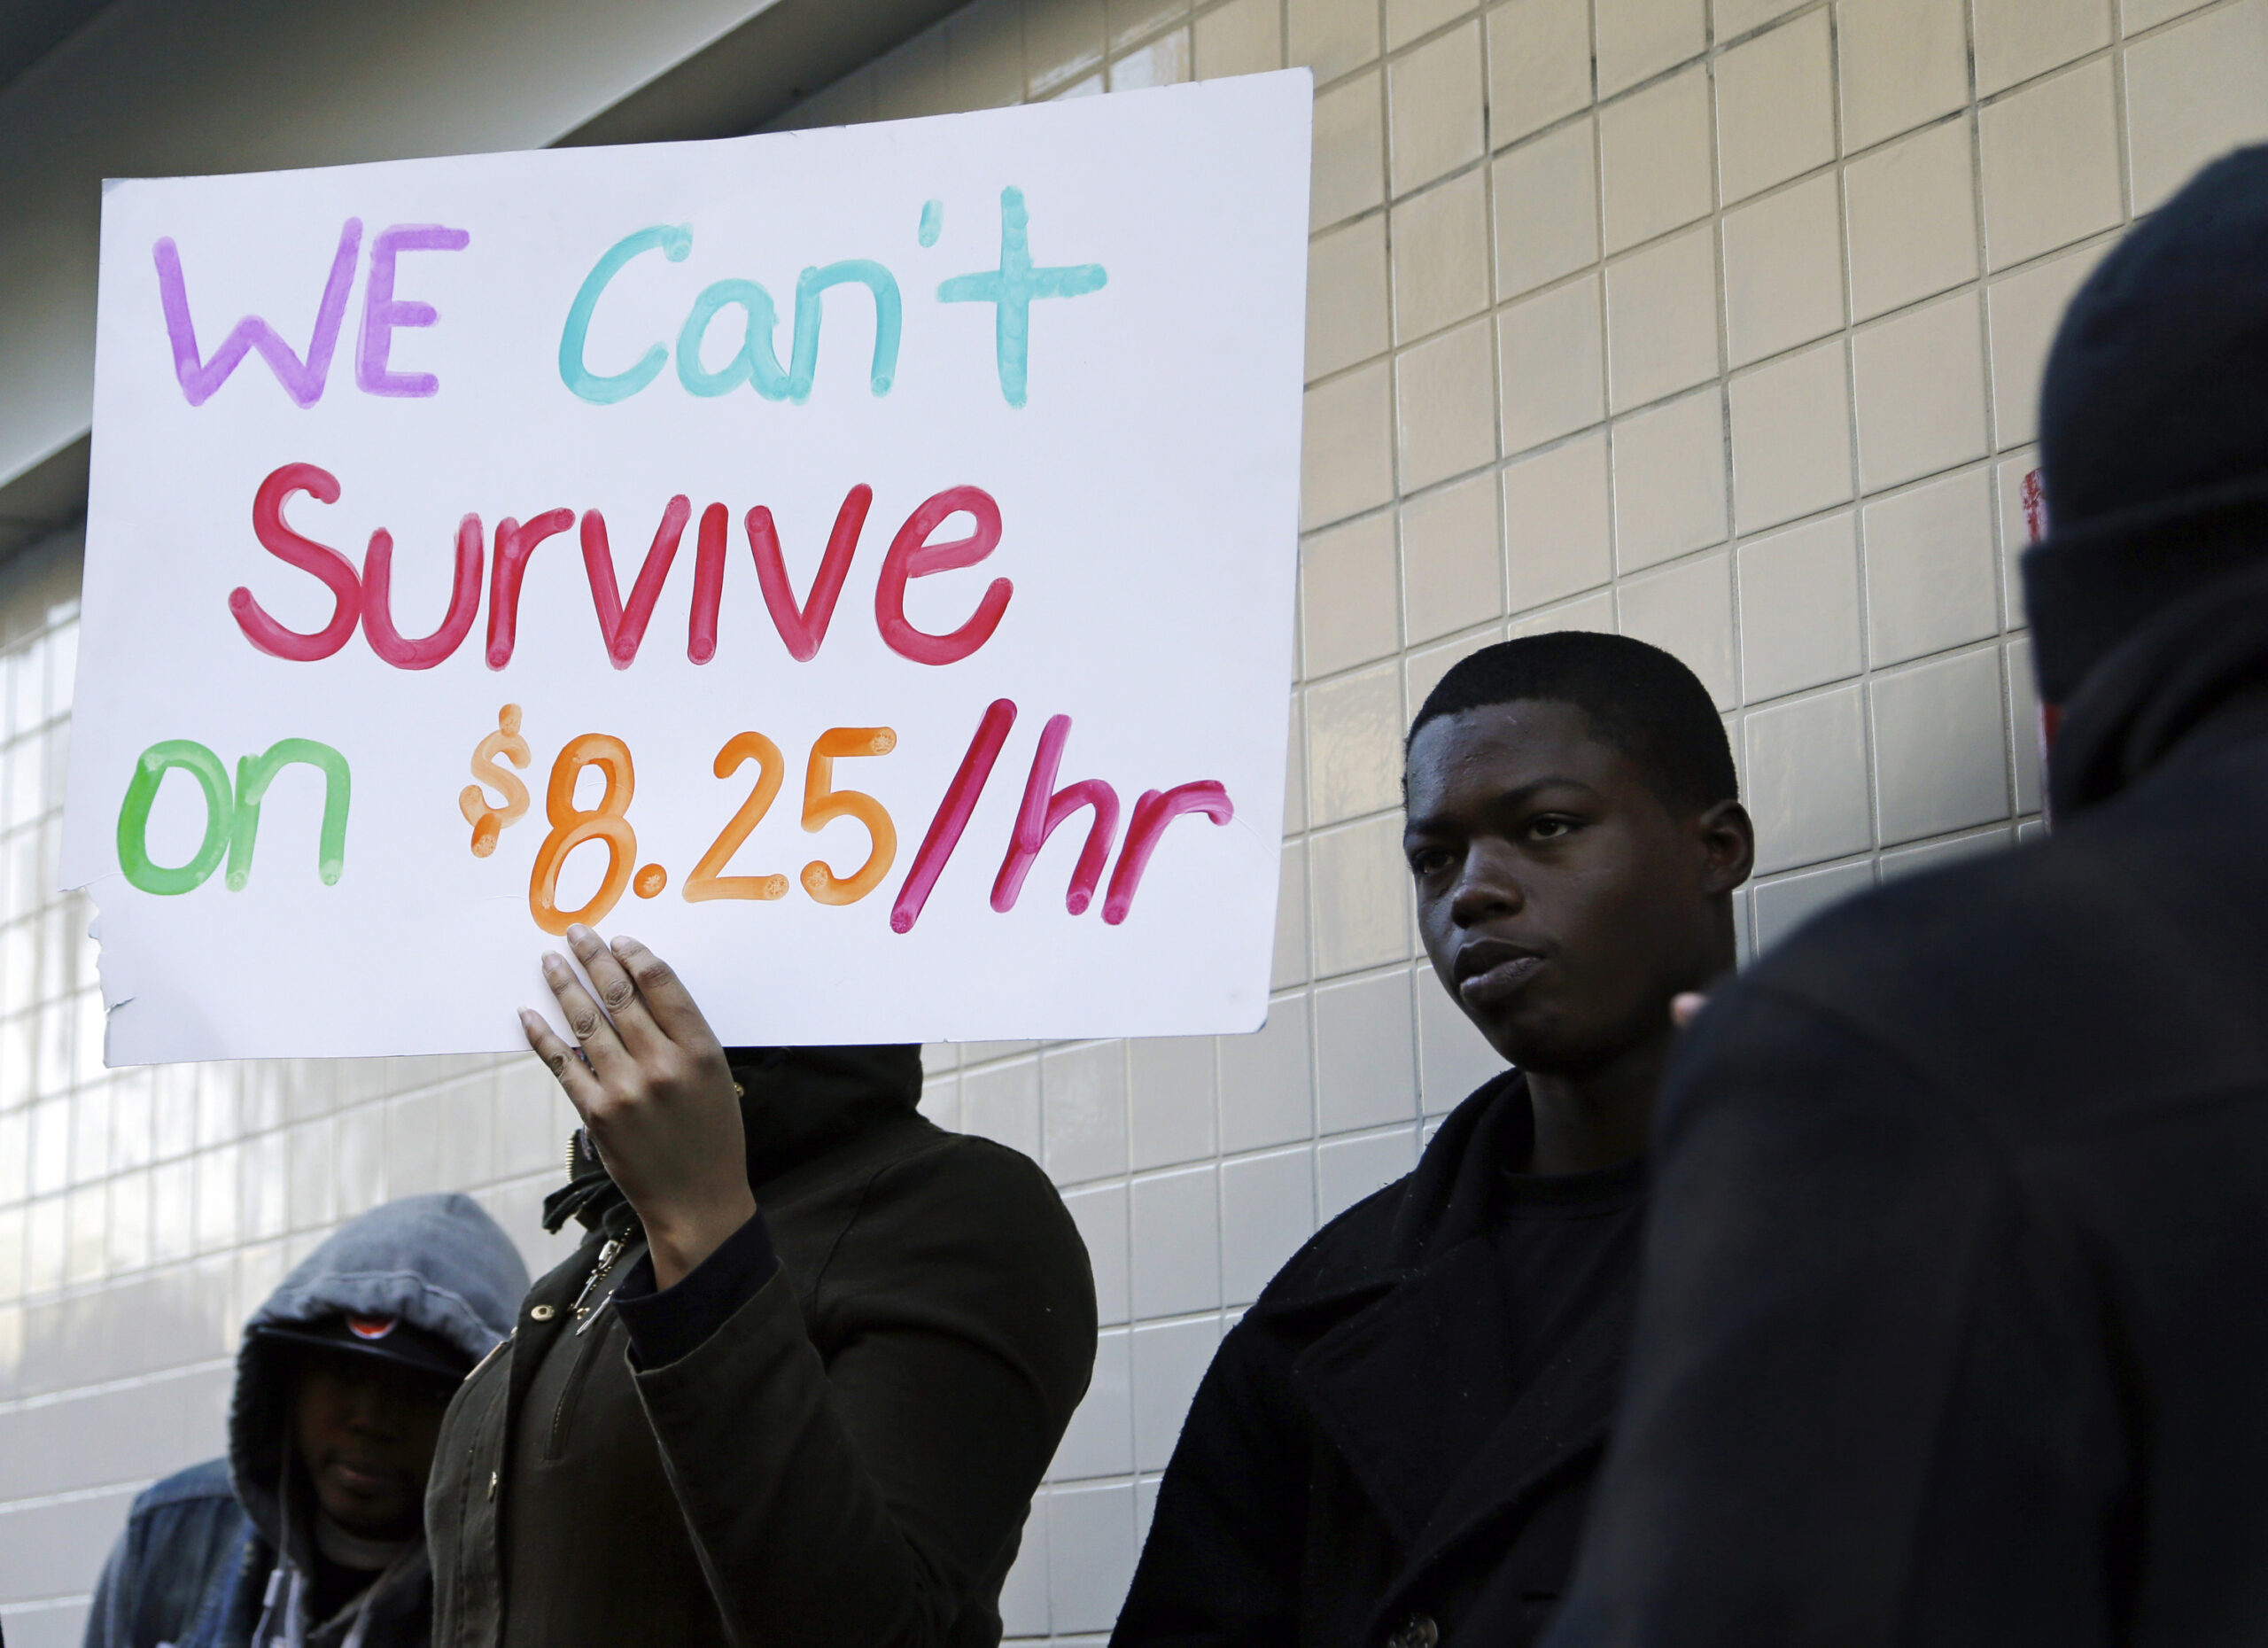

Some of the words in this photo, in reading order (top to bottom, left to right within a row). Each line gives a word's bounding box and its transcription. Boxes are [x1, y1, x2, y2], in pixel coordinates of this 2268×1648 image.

[155, 218, 470, 408] WE
[559, 184, 1107, 408] Can't
[229, 463, 1014, 671] Survive
[117, 737, 351, 896] on
[459, 698, 1233, 935] $8.25/hr
